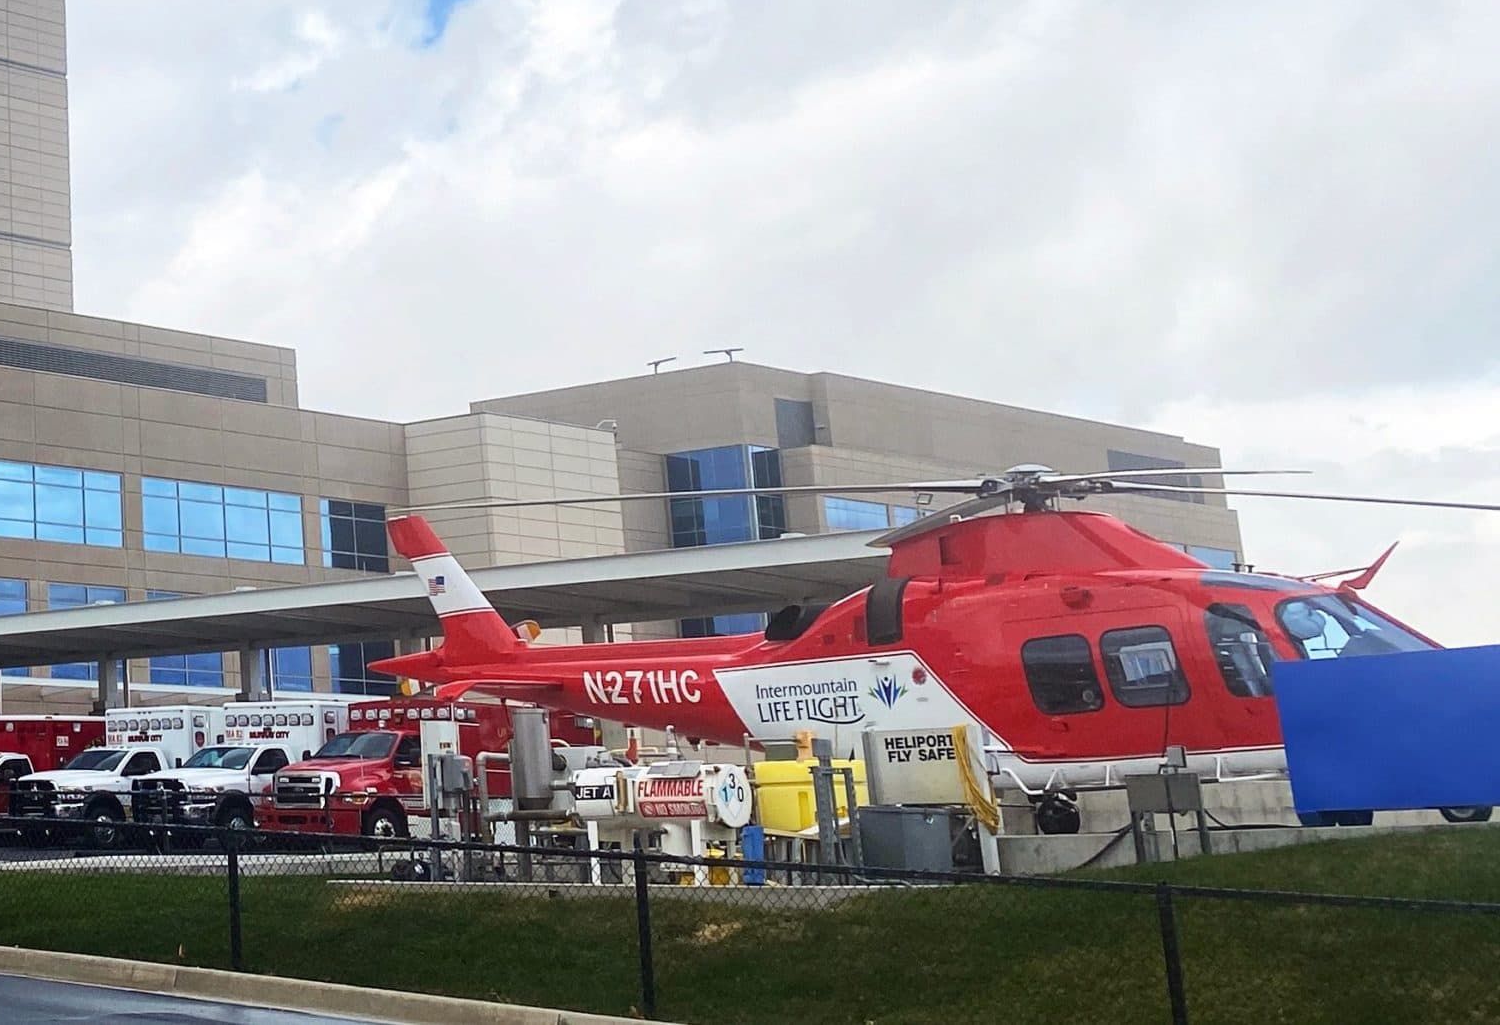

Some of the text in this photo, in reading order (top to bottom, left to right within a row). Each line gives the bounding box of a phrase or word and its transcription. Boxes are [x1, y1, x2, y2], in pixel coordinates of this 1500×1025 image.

[583, 669, 702, 705] N271HC
[756, 678, 858, 699] Intermountain
[758, 695, 865, 725] LIFE FLIGHT
[276, 730, 290, 739] CITY
[884, 735, 954, 750] HELIPORT
[888, 748, 956, 763] FLY SAFE
[638, 779, 704, 798] FLAMMABLE
[728, 774, 736, 789] 3
[576, 786, 612, 800] JET A
[655, 803, 668, 816] NO
